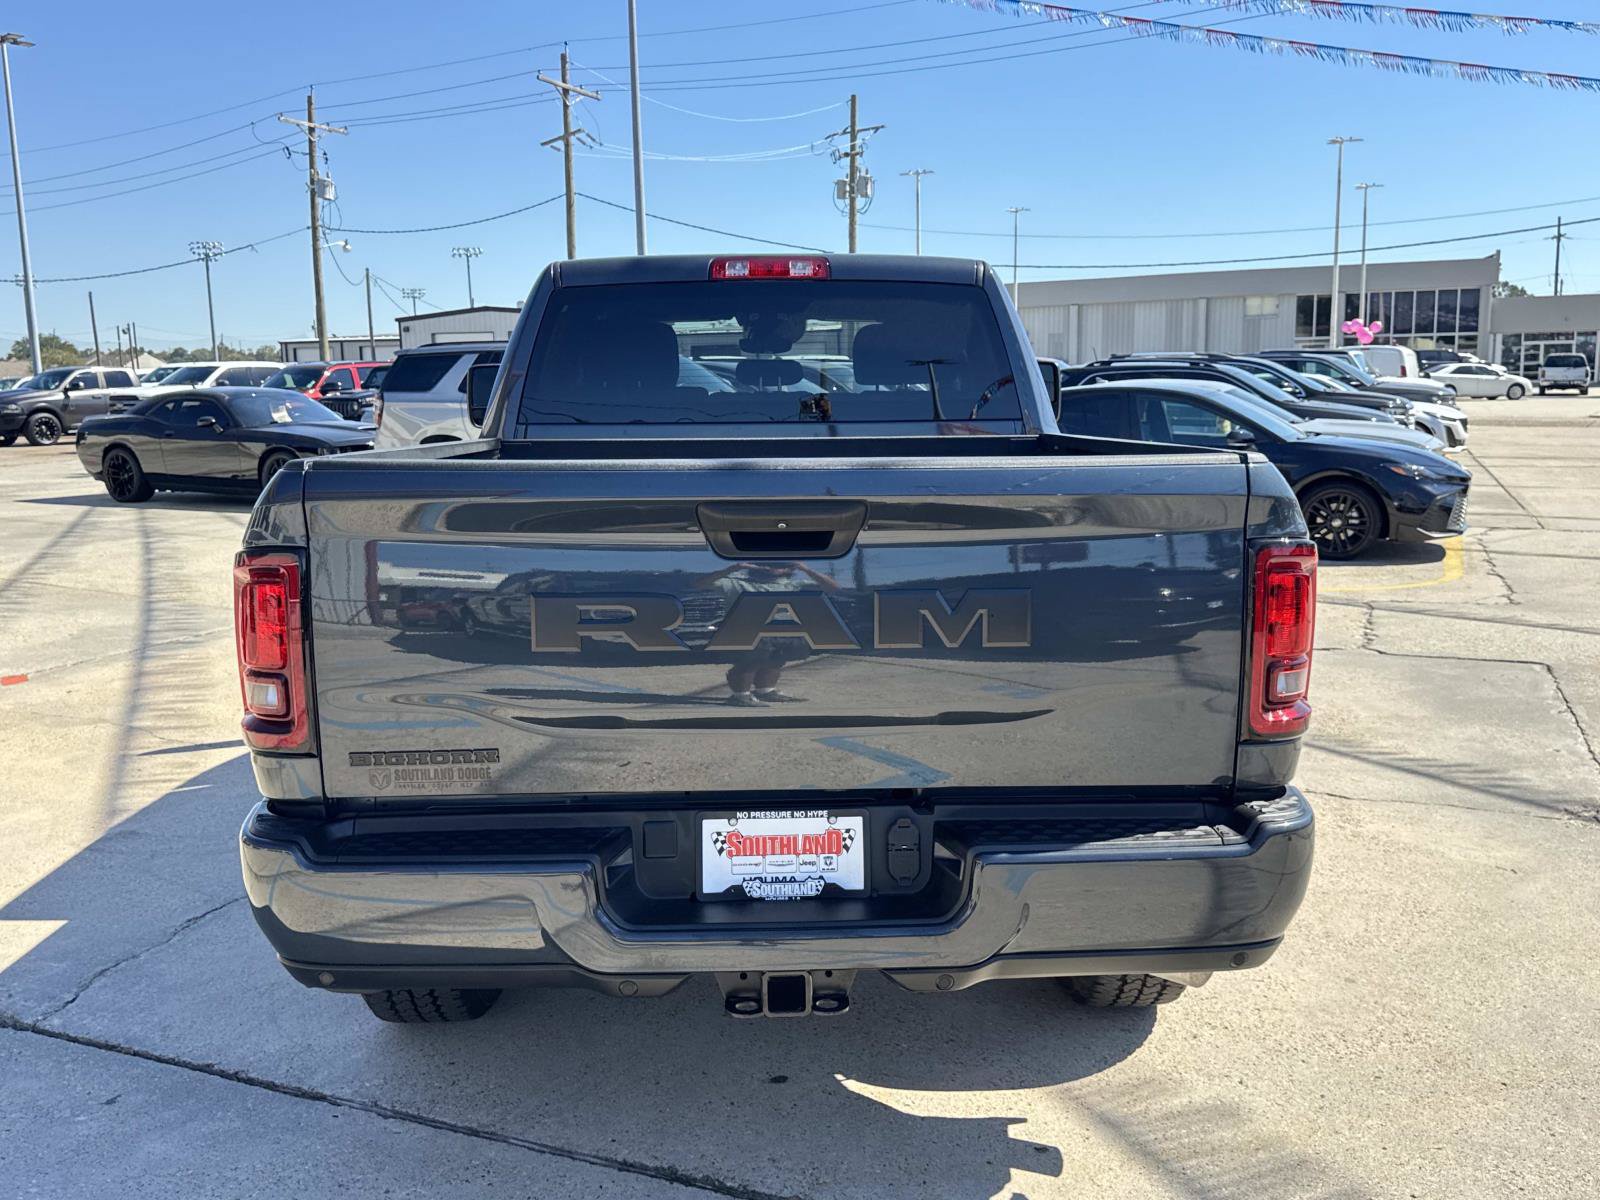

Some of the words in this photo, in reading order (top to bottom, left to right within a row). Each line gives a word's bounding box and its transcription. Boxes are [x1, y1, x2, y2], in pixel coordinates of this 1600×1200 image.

[531, 588, 1032, 652] RAM
[349, 748, 500, 766] BIGHORN
[394, 767, 455, 781] SOUTHLAND
[459, 766, 492, 780] DODGE
[736, 811, 749, 819] NO
[750, 811, 792, 819] PRESSURE
[807, 810, 829, 818] HYPE
[727, 829, 842, 858] SOUTHLAND
[799, 859, 817, 867] Jeep
[751, 881, 817, 897] SOUTHLAND
